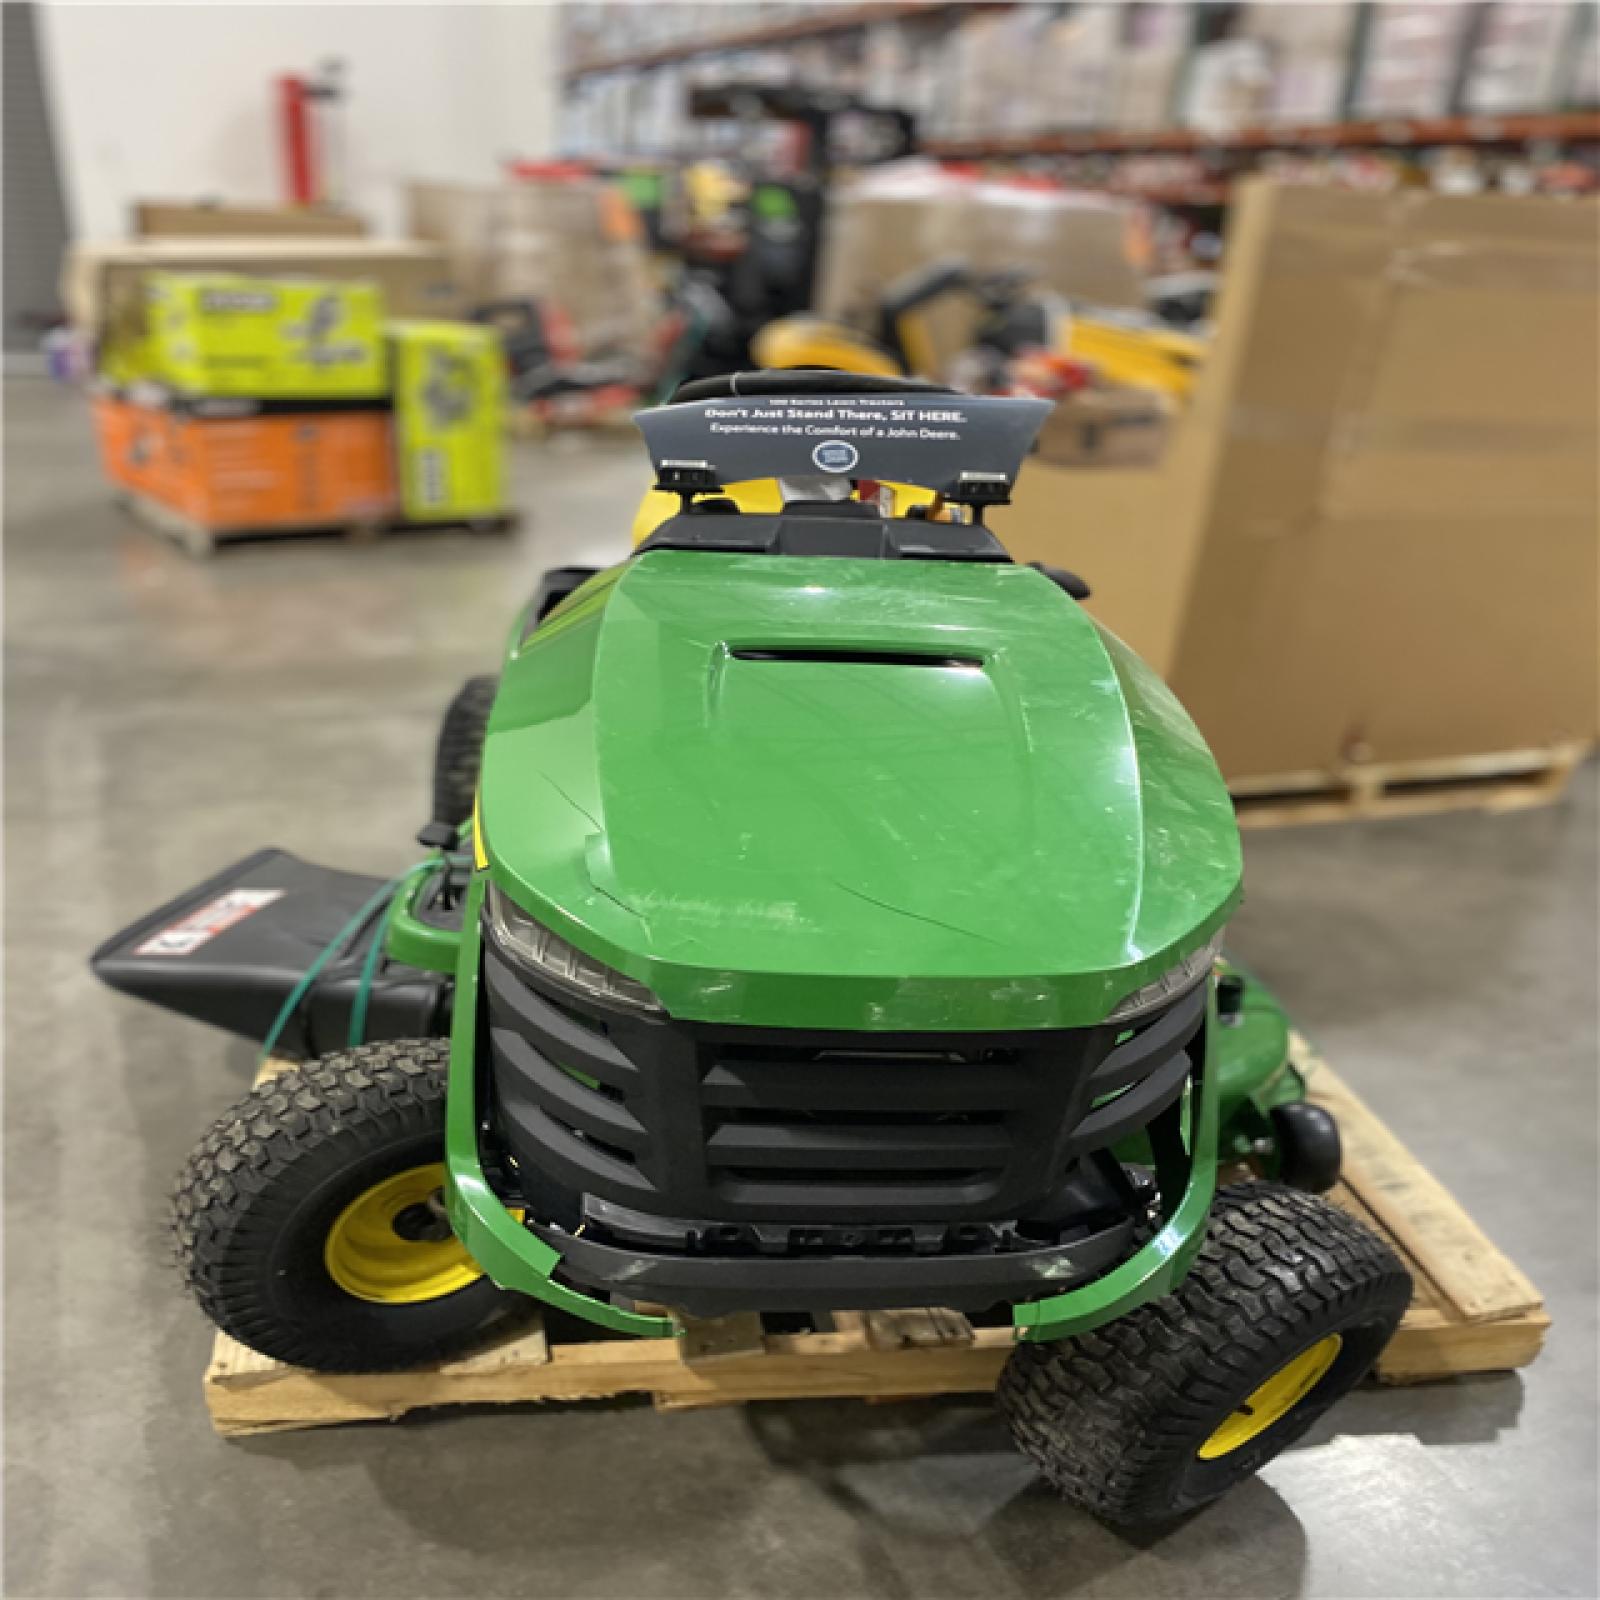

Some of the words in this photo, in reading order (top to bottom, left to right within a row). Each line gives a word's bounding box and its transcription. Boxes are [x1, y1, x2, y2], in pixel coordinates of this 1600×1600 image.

[704, 408, 748, 418] Don't
[751, 409, 783, 418] Just
[787, 409, 833, 419] Stand
[837, 410, 888, 421] There,
[890, 410, 915, 421] SIT
[919, 410, 968, 422] HERE.
[710, 422, 778, 434] Experience
[782, 424, 803, 434] the
[804, 425, 856, 436] Comfort
[859, 425, 875, 437] of
[876, 429, 885, 437] a
[887, 427, 919, 438] John
